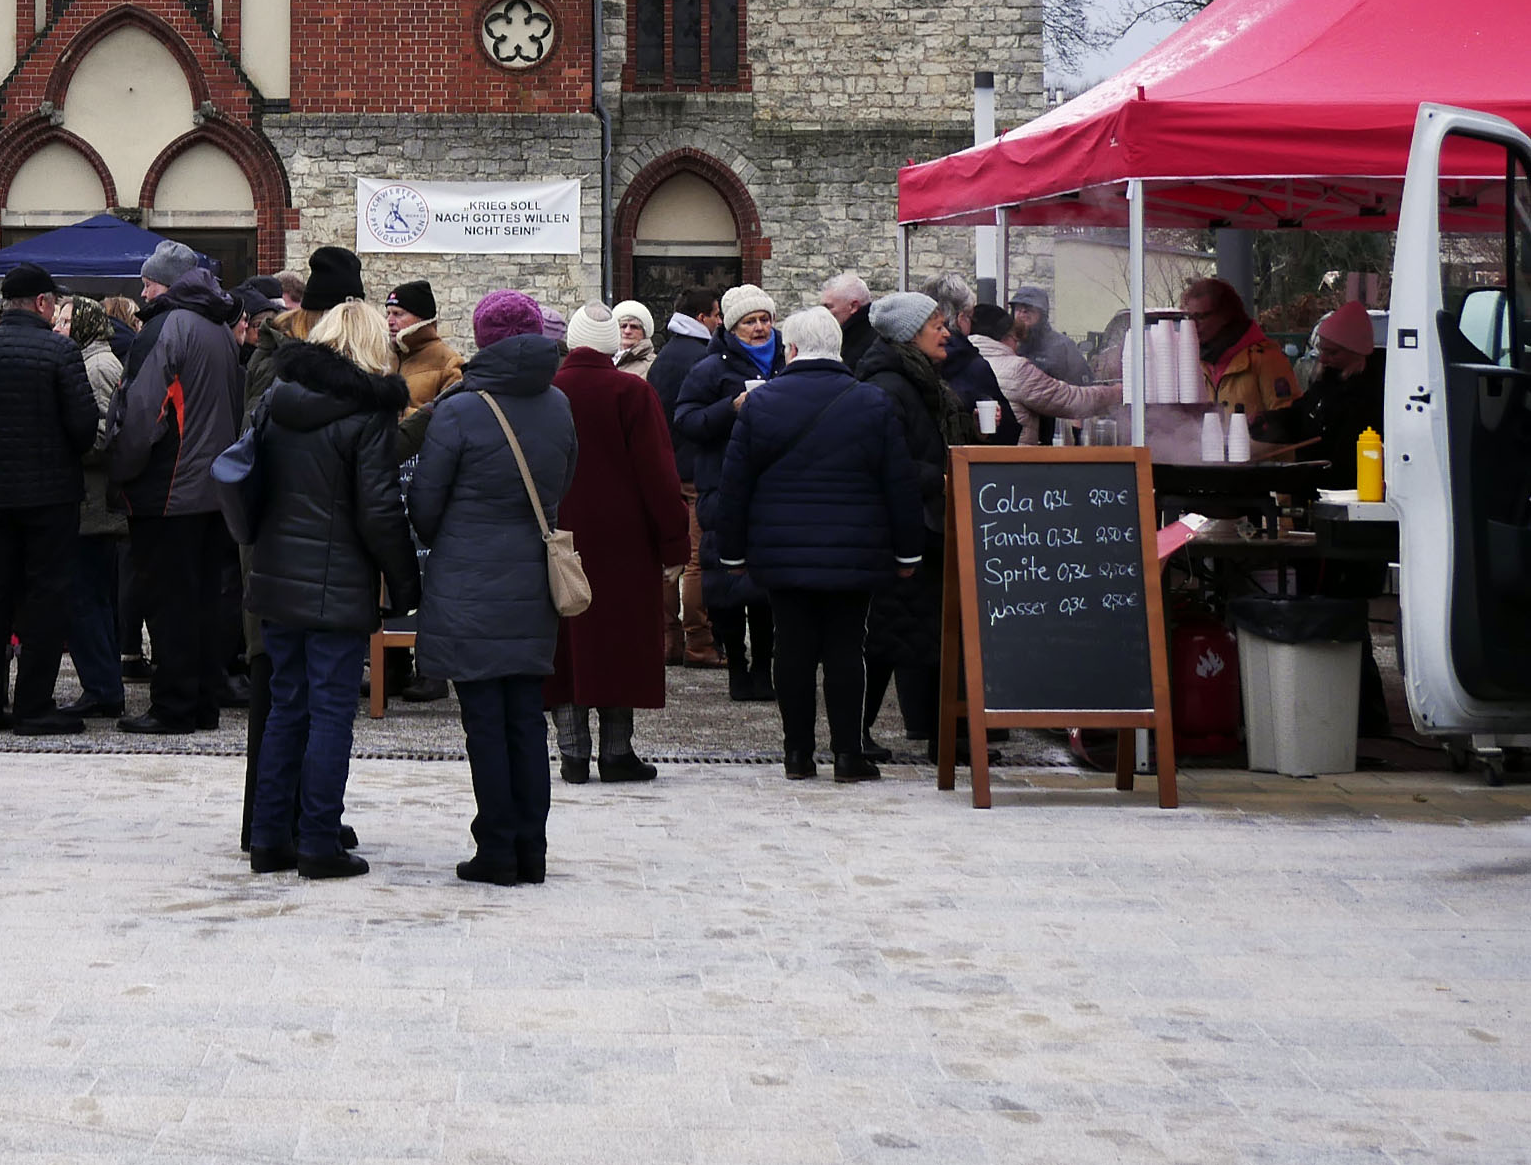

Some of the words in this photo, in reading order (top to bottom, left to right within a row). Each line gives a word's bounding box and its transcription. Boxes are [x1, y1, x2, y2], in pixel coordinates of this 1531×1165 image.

[370, 188, 417, 212] SCHWERTER
[415, 201, 426, 212] ZU
[510, 201, 542, 211] SOLL
[370, 217, 426, 244] PFLUGSCHAREN
[435, 213, 469, 223] NACH
[472, 213, 521, 223] GOTTES
[524, 213, 570, 223] WILLEN
[464, 226, 500, 236] NICHT
[979, 483, 1033, 514] Cola
[1043, 490, 1073, 511] 0,3L
[980, 521, 1041, 551] Fanta
[1047, 528, 1083, 548] 0,3L
[984, 555, 1050, 593] Sprite
[1057, 562, 1092, 583] 0,3L
[987, 598, 1049, 627] Wasser
[1059, 597, 1088, 616] 0,3L
